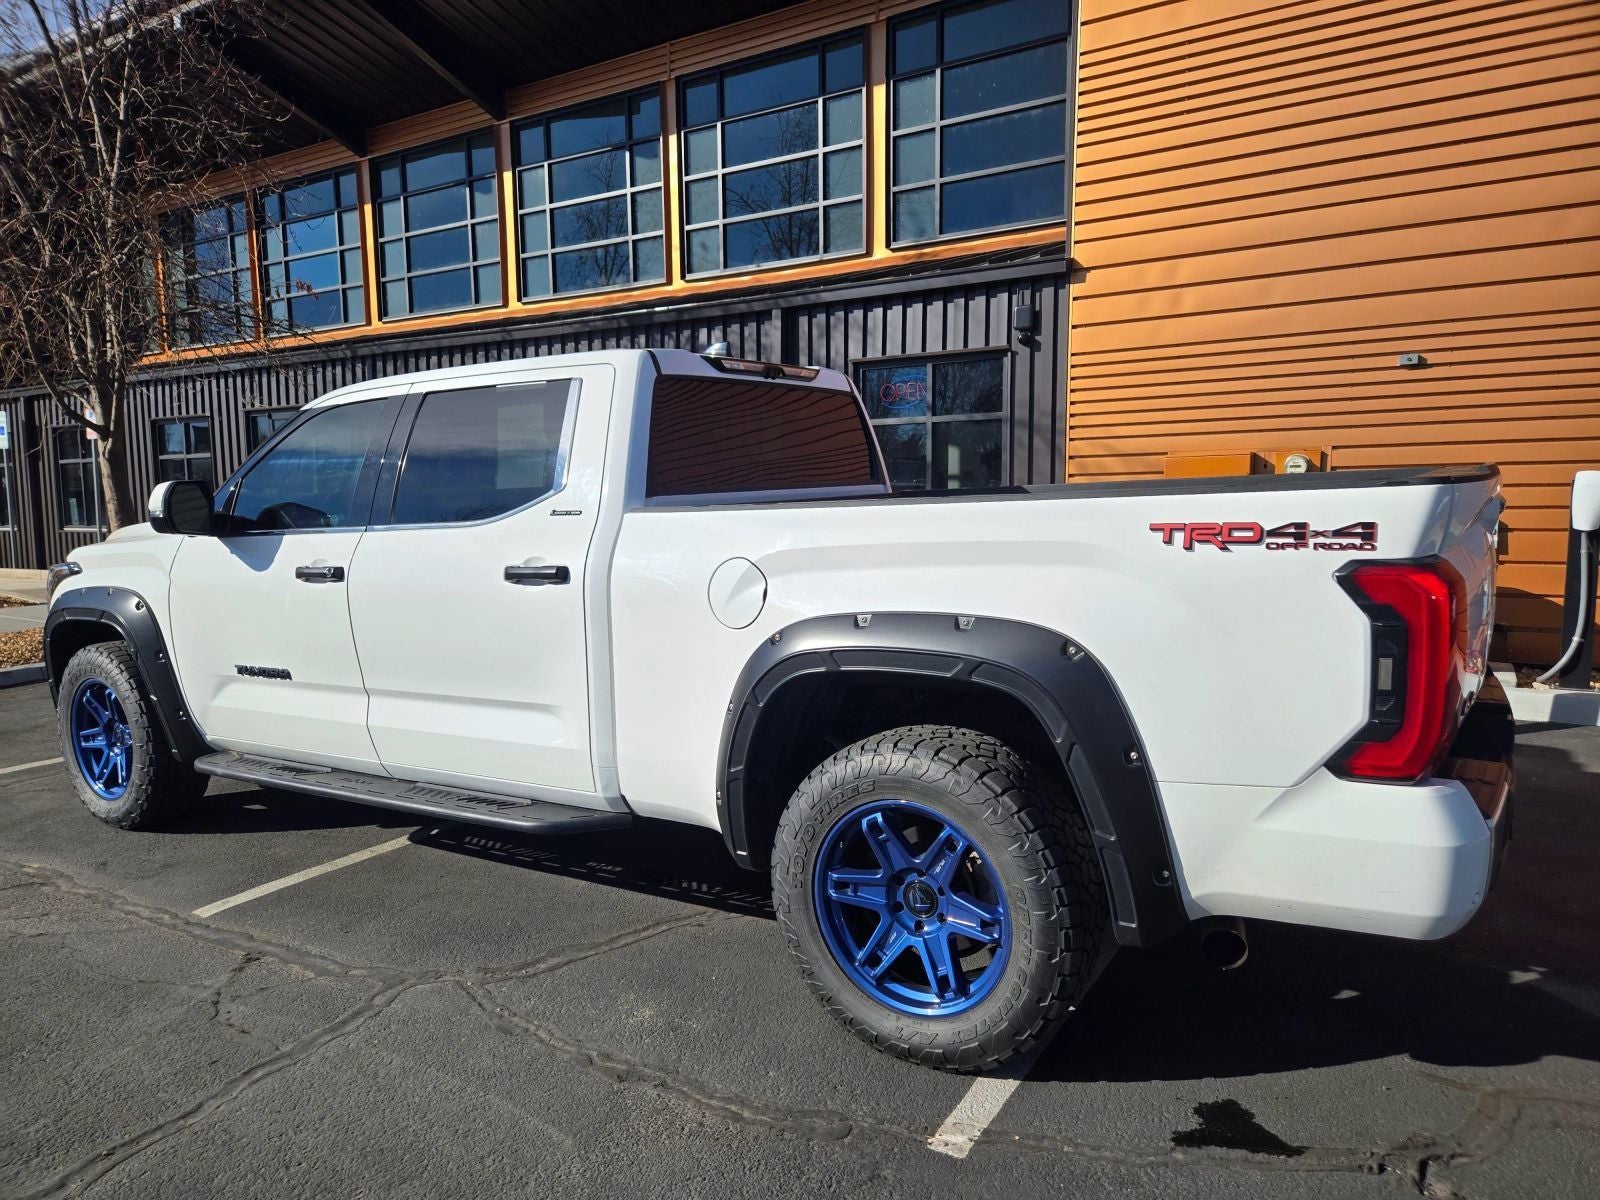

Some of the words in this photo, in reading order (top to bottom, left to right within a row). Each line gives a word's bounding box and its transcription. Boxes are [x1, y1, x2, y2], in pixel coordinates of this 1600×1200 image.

[880, 382, 928, 402] OPEN
[1149, 522, 1266, 552] TRD
[1265, 542, 1309, 551] OFF
[1313, 542, 1378, 551] ROAD
[234, 664, 293, 681] TUNDRA
[791, 822, 816, 889] TOYO
[813, 778, 876, 825] TIRES
